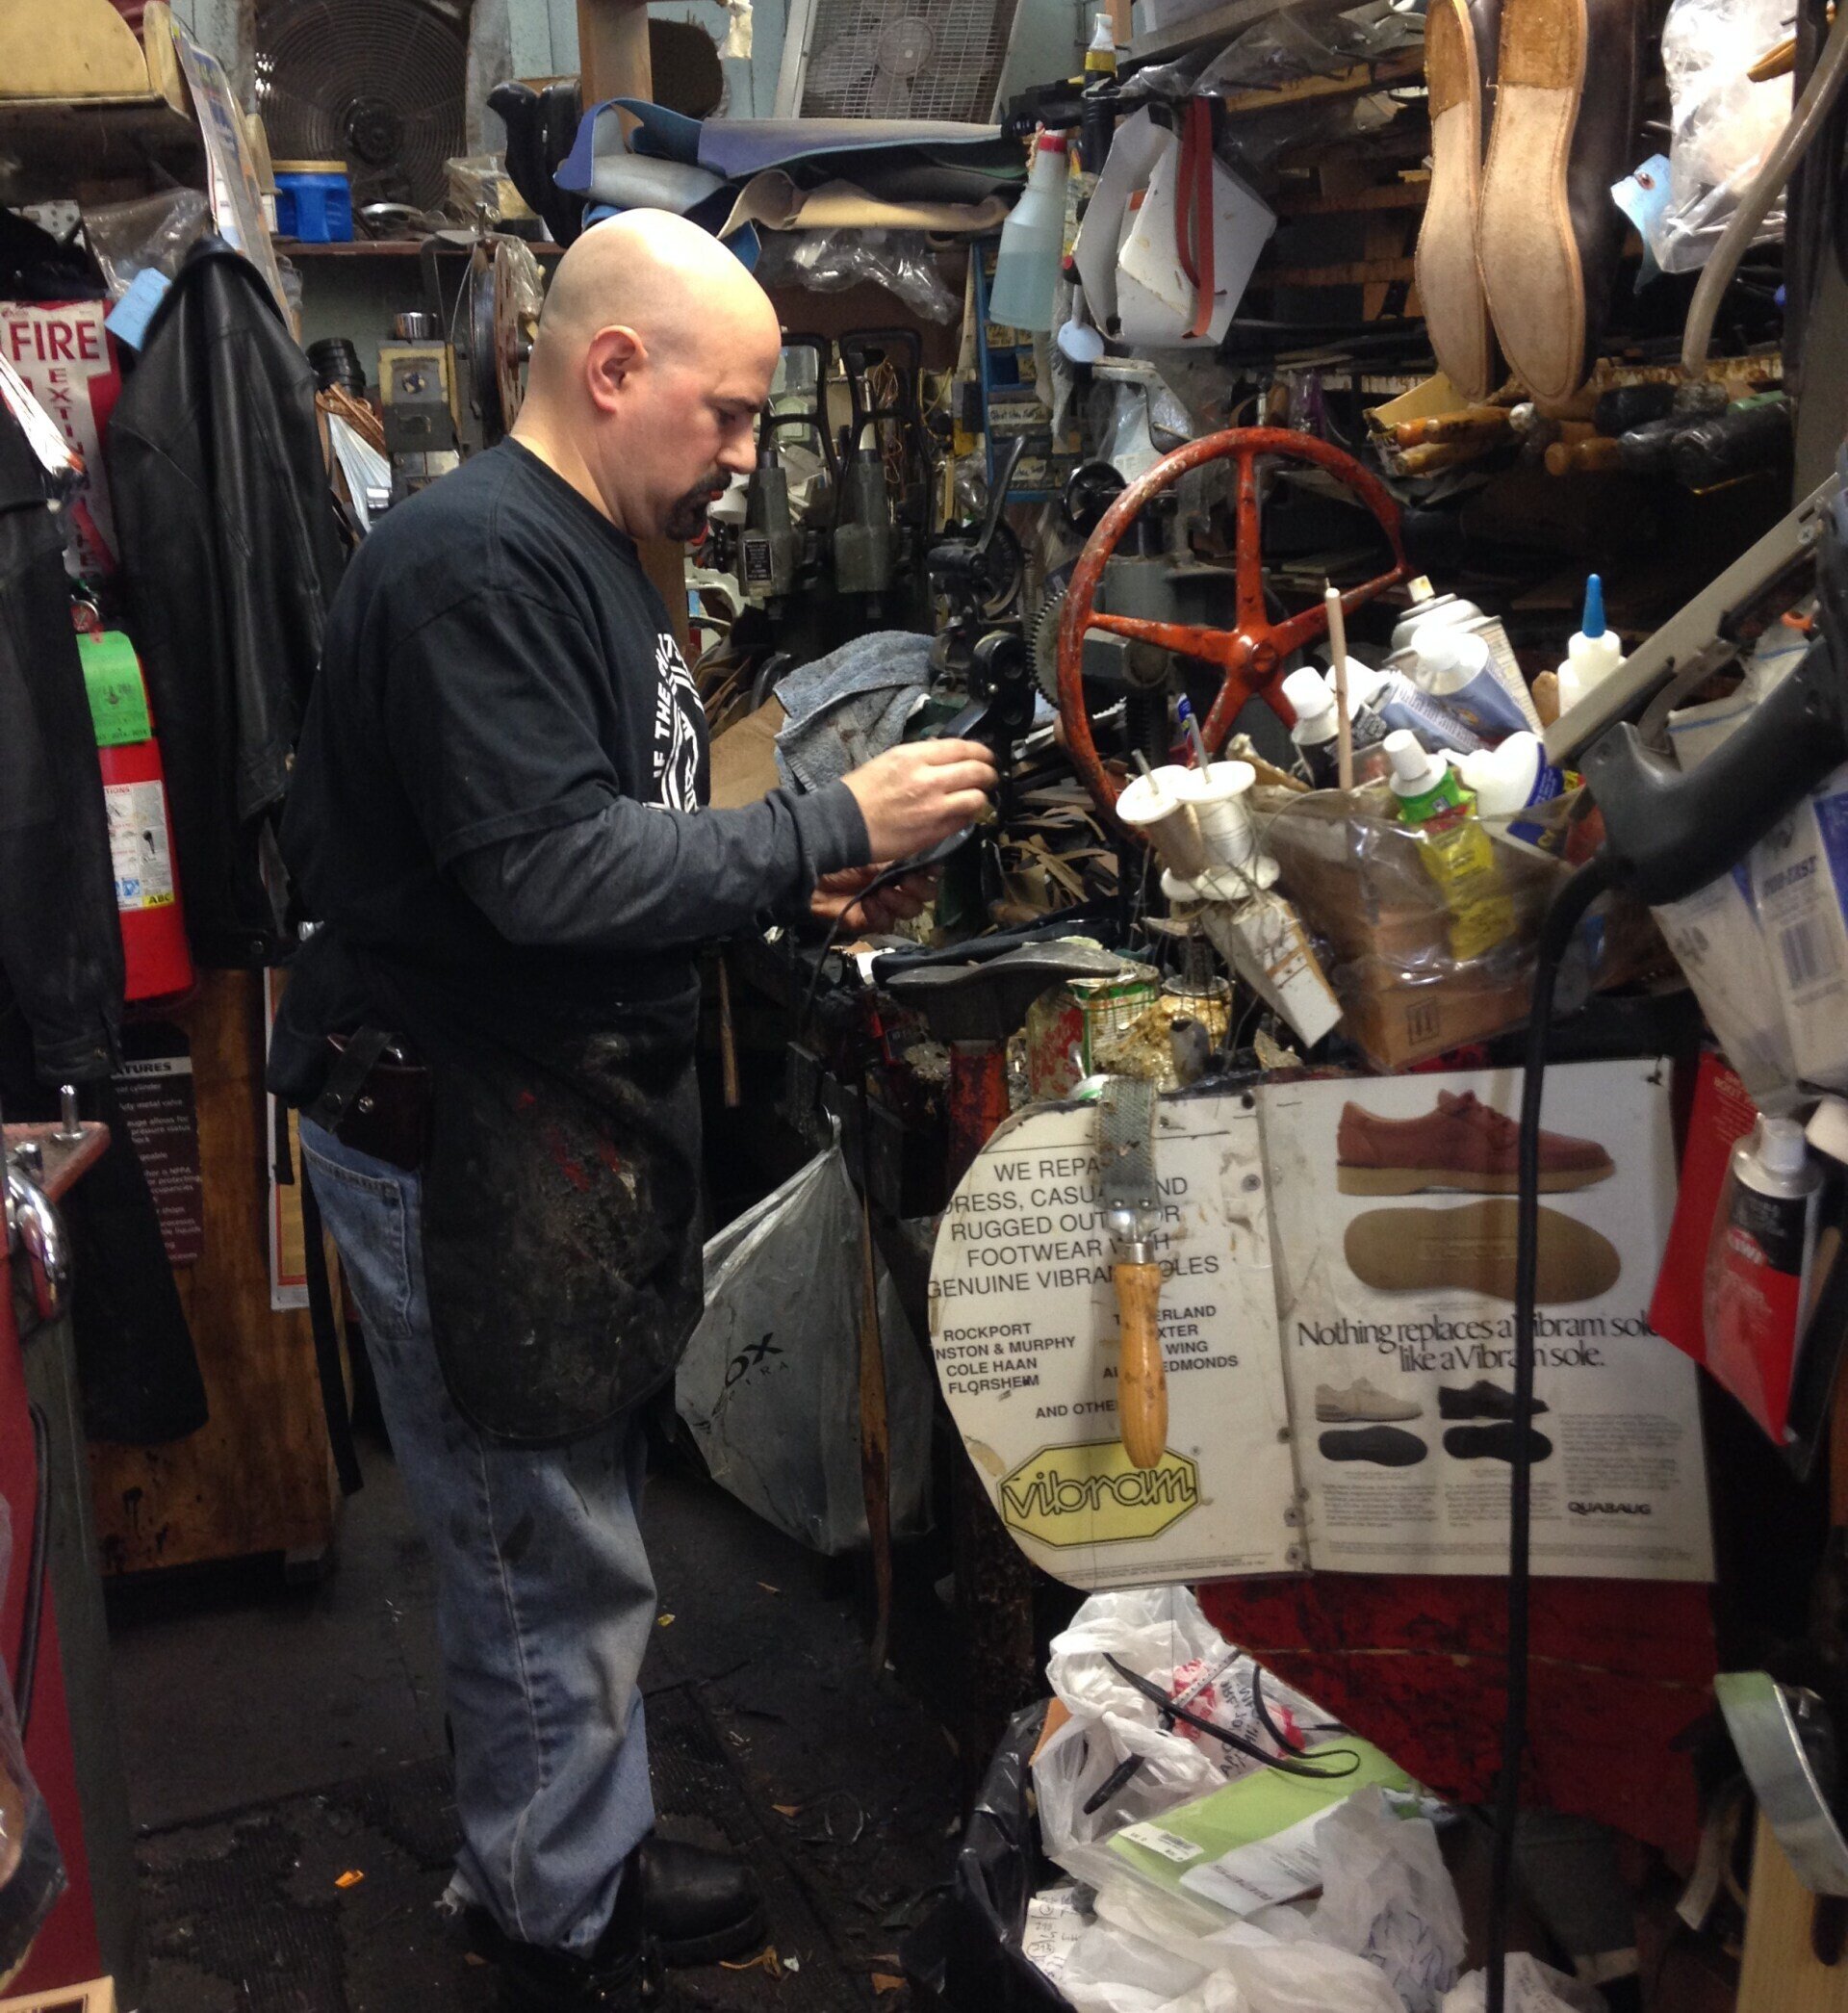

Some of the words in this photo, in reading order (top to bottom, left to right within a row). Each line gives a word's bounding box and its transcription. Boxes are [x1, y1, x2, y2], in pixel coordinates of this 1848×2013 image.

[9, 320, 100, 362] FIRE
[654, 682, 672, 739] THE
[147, 892, 172, 905] ABC
[124, 1061, 172, 1075] TURES
[994, 1162, 1031, 1182] WE
[1040, 1156, 1103, 1178] REPA
[1031, 1185, 1104, 1208] CASU
[1156, 1176, 1189, 1196] ND
[950, 1216, 1053, 1242] RUGGED
[1059, 1204, 1180, 1233] OUTR
[966, 1239, 1103, 1269] FOOTWEAR
[927, 1272, 1031, 1300] GENUINE
[1158, 1254, 1220, 1280] OLES
[943, 1322, 1033, 1343] ROCKPORT
[1157, 1324, 1198, 1340] XTER
[1298, 1318, 1397, 1355] Nothing
[1398, 1313, 1493, 1349] replaces
[1497, 1319, 1512, 1339] a
[1514, 1309, 1606, 1337] ibram
[935, 1344, 990, 1361] NSTON
[993, 1342, 1005, 1355] &
[1008, 1335, 1077, 1355] MURPHY
[1166, 1340, 1210, 1355] WING
[1399, 1347, 1436, 1373] like
[1441, 1351, 1455, 1370] a
[1551, 1339, 1605, 1367] sole.
[946, 1360, 988, 1378] COLE
[992, 1356, 1038, 1373] HAAN
[948, 1374, 1040, 1395] FLORSHEIM
[1035, 1403, 1068, 1419] AND
[1073, 1399, 1116, 1416] OTHE
[1002, 1466, 1198, 1520] vibram
[1567, 1501, 1652, 1515] QUABAUG
